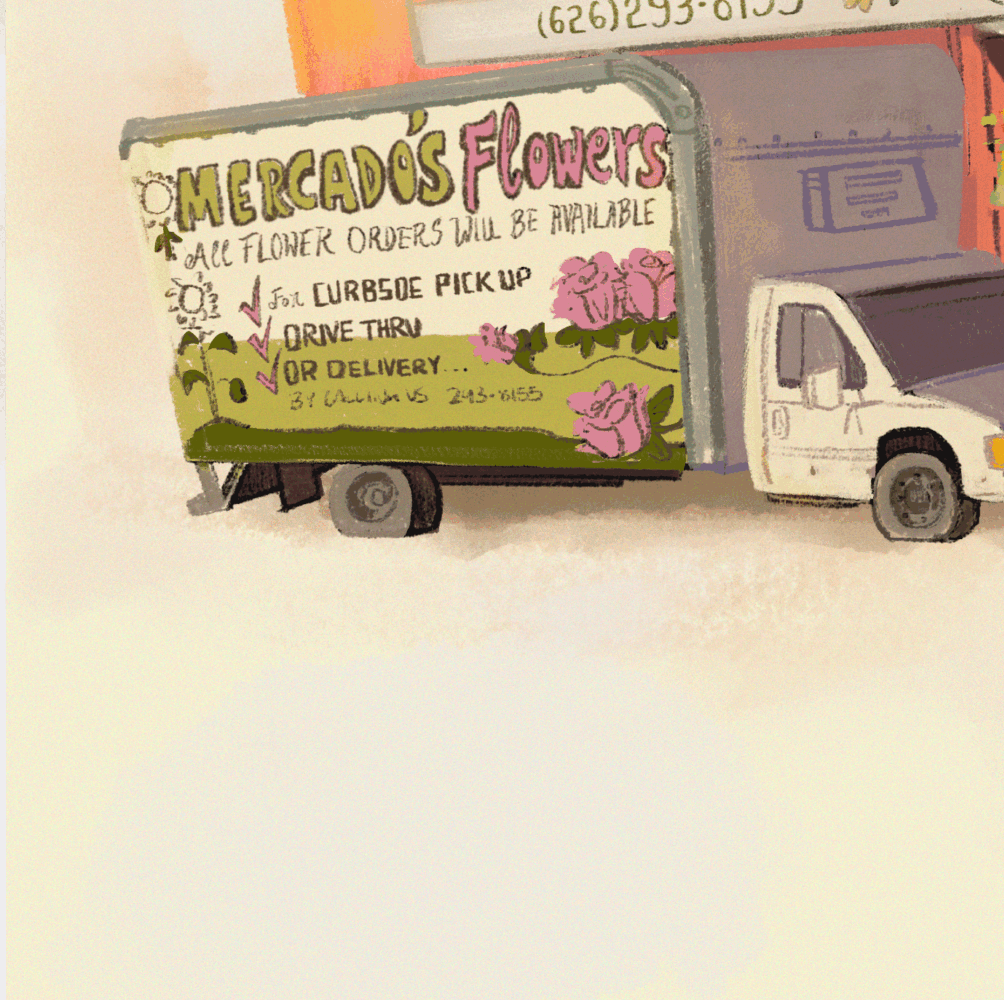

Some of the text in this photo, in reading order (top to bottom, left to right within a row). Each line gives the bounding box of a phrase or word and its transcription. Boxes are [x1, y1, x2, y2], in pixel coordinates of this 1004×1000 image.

[239, 231, 335, 264] FLOWER
[347, 216, 443, 254] ORDERS
[510, 207, 539, 240] BE
[548, 197, 657, 236] AVAILABLE
[435, 270, 495, 297] PICK
[497, 265, 532, 292] UP
[283, 319, 354, 352] DRIVE
[283, 359, 319, 386] OR
